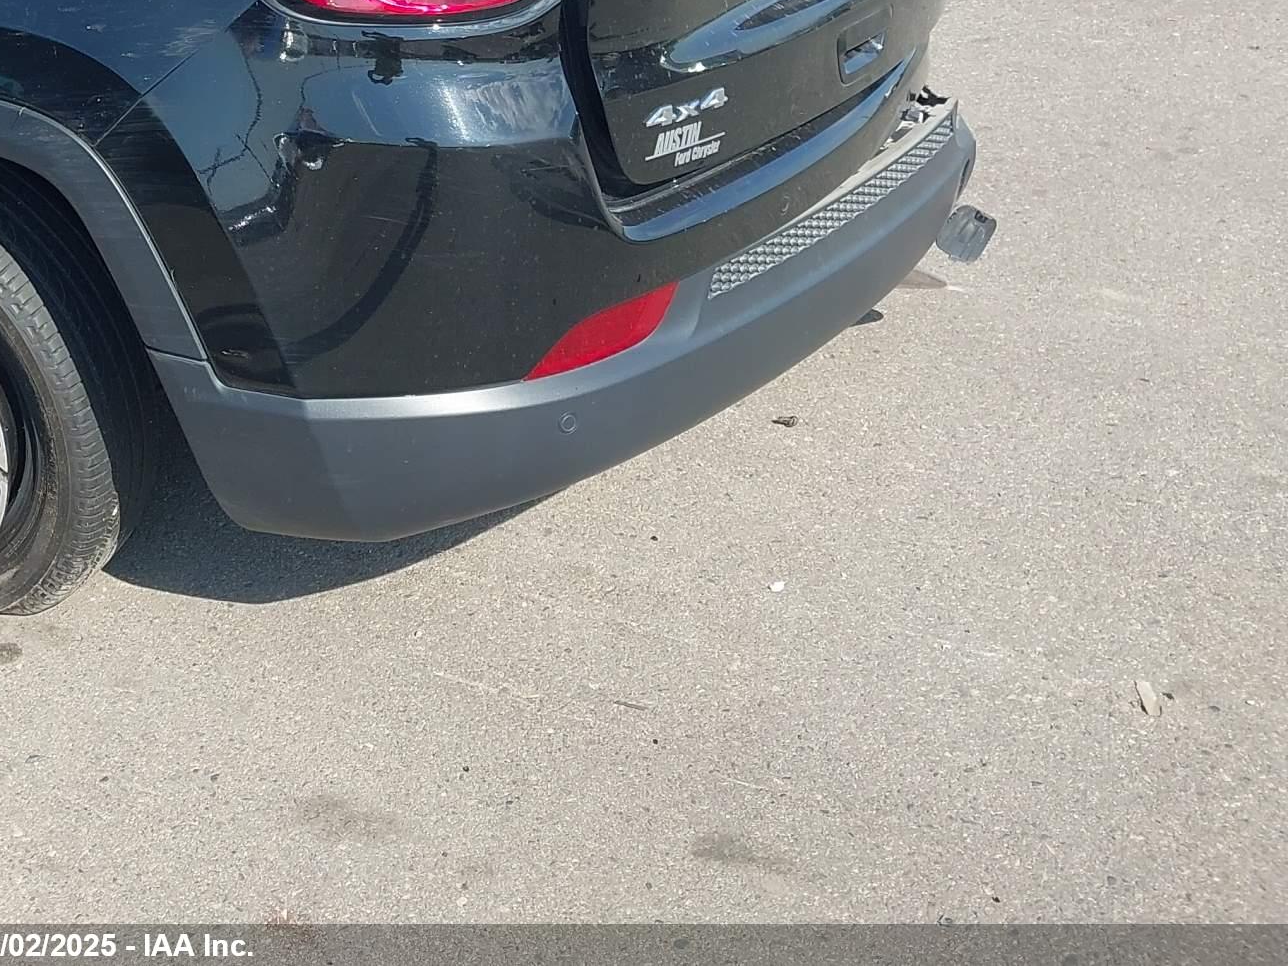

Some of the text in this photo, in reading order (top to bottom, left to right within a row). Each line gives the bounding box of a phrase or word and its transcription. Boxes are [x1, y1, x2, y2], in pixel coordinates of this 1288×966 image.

[644, 87, 729, 128] 4x4
[653, 121, 703, 156] AUSTIN
[674, 140, 721, 167] Ford Chrysler
